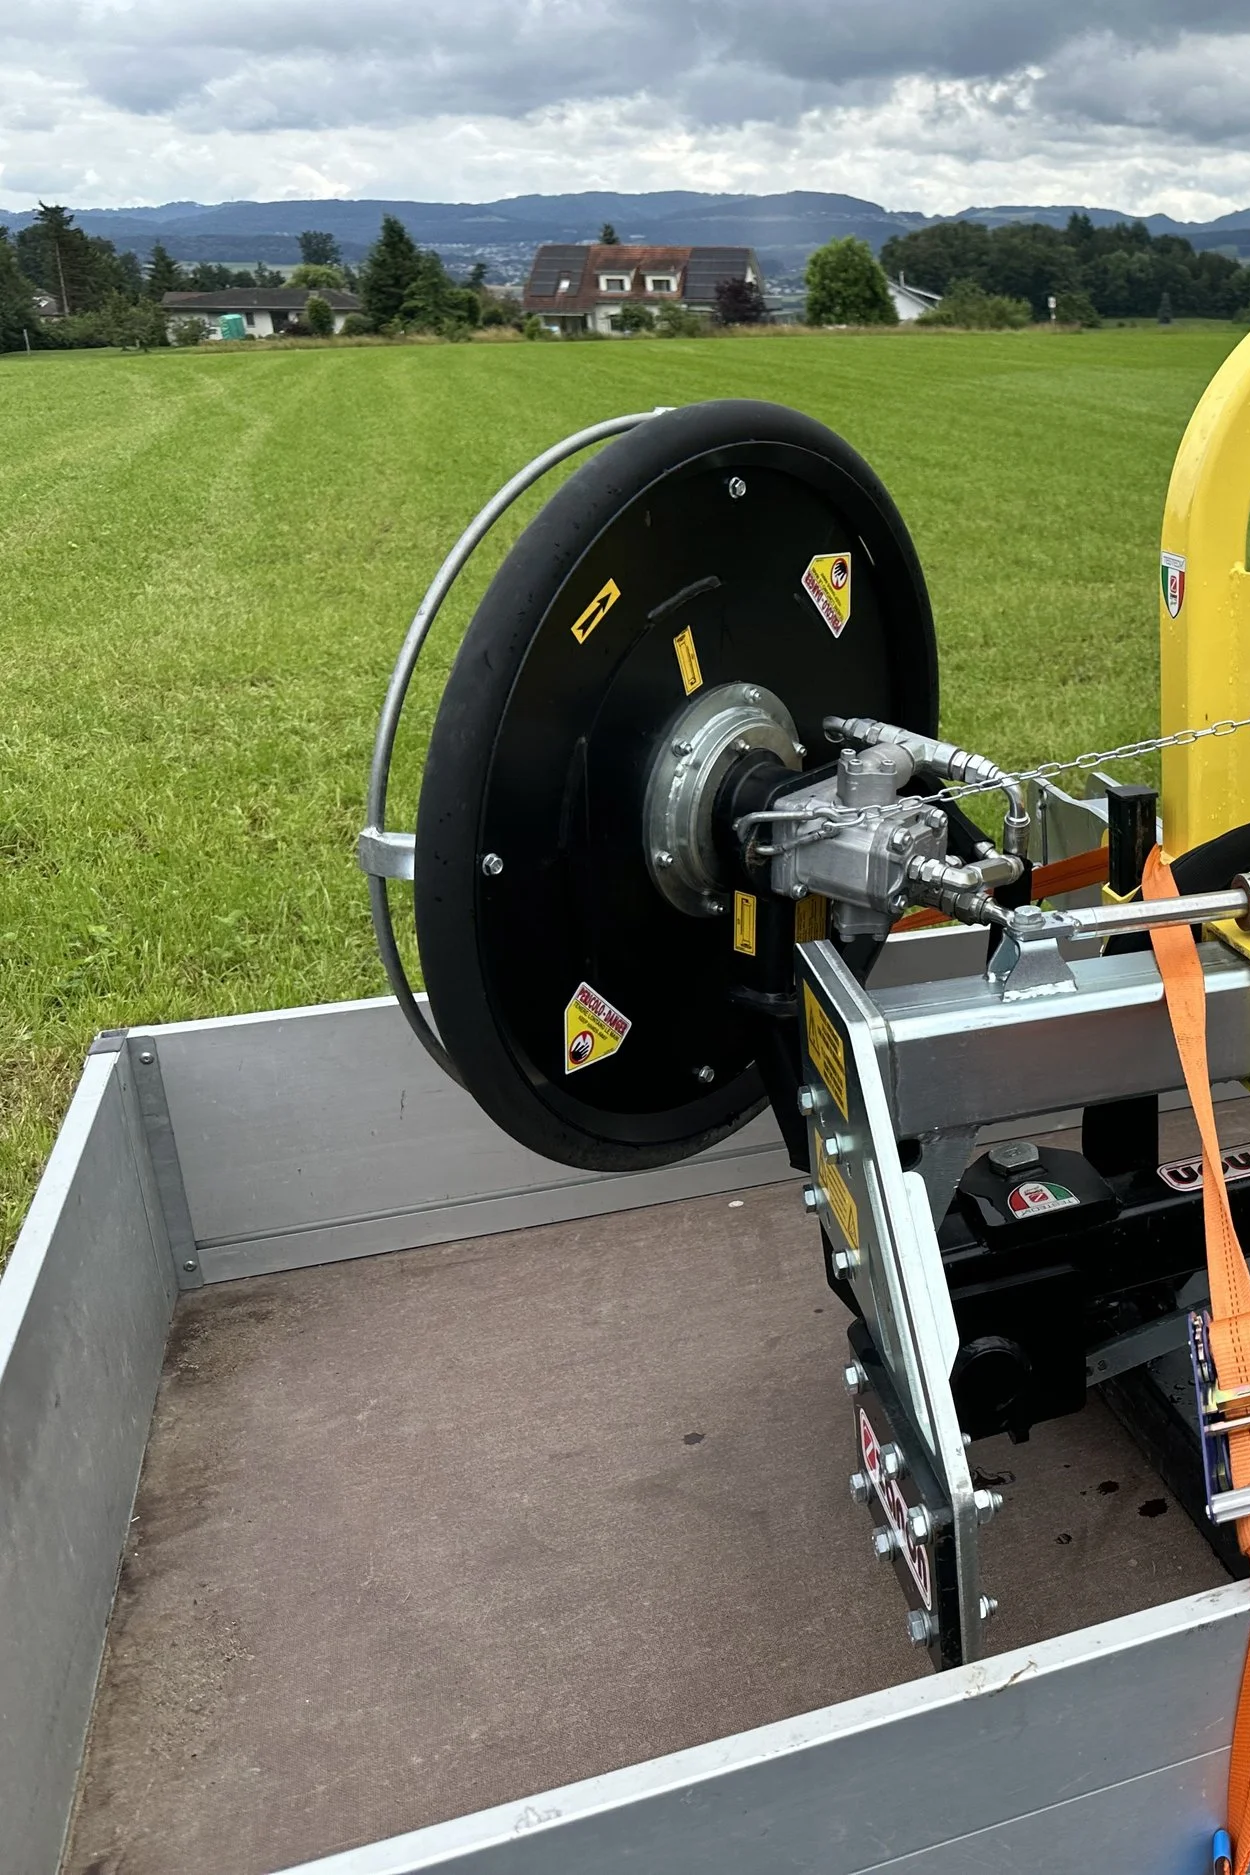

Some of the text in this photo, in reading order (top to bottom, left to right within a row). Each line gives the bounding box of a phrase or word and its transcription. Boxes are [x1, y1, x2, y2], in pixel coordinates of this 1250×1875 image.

[804, 571, 824, 601] DANGER
[577, 987, 606, 1016] PERICOLO
[603, 1010, 628, 1035] DANGER
